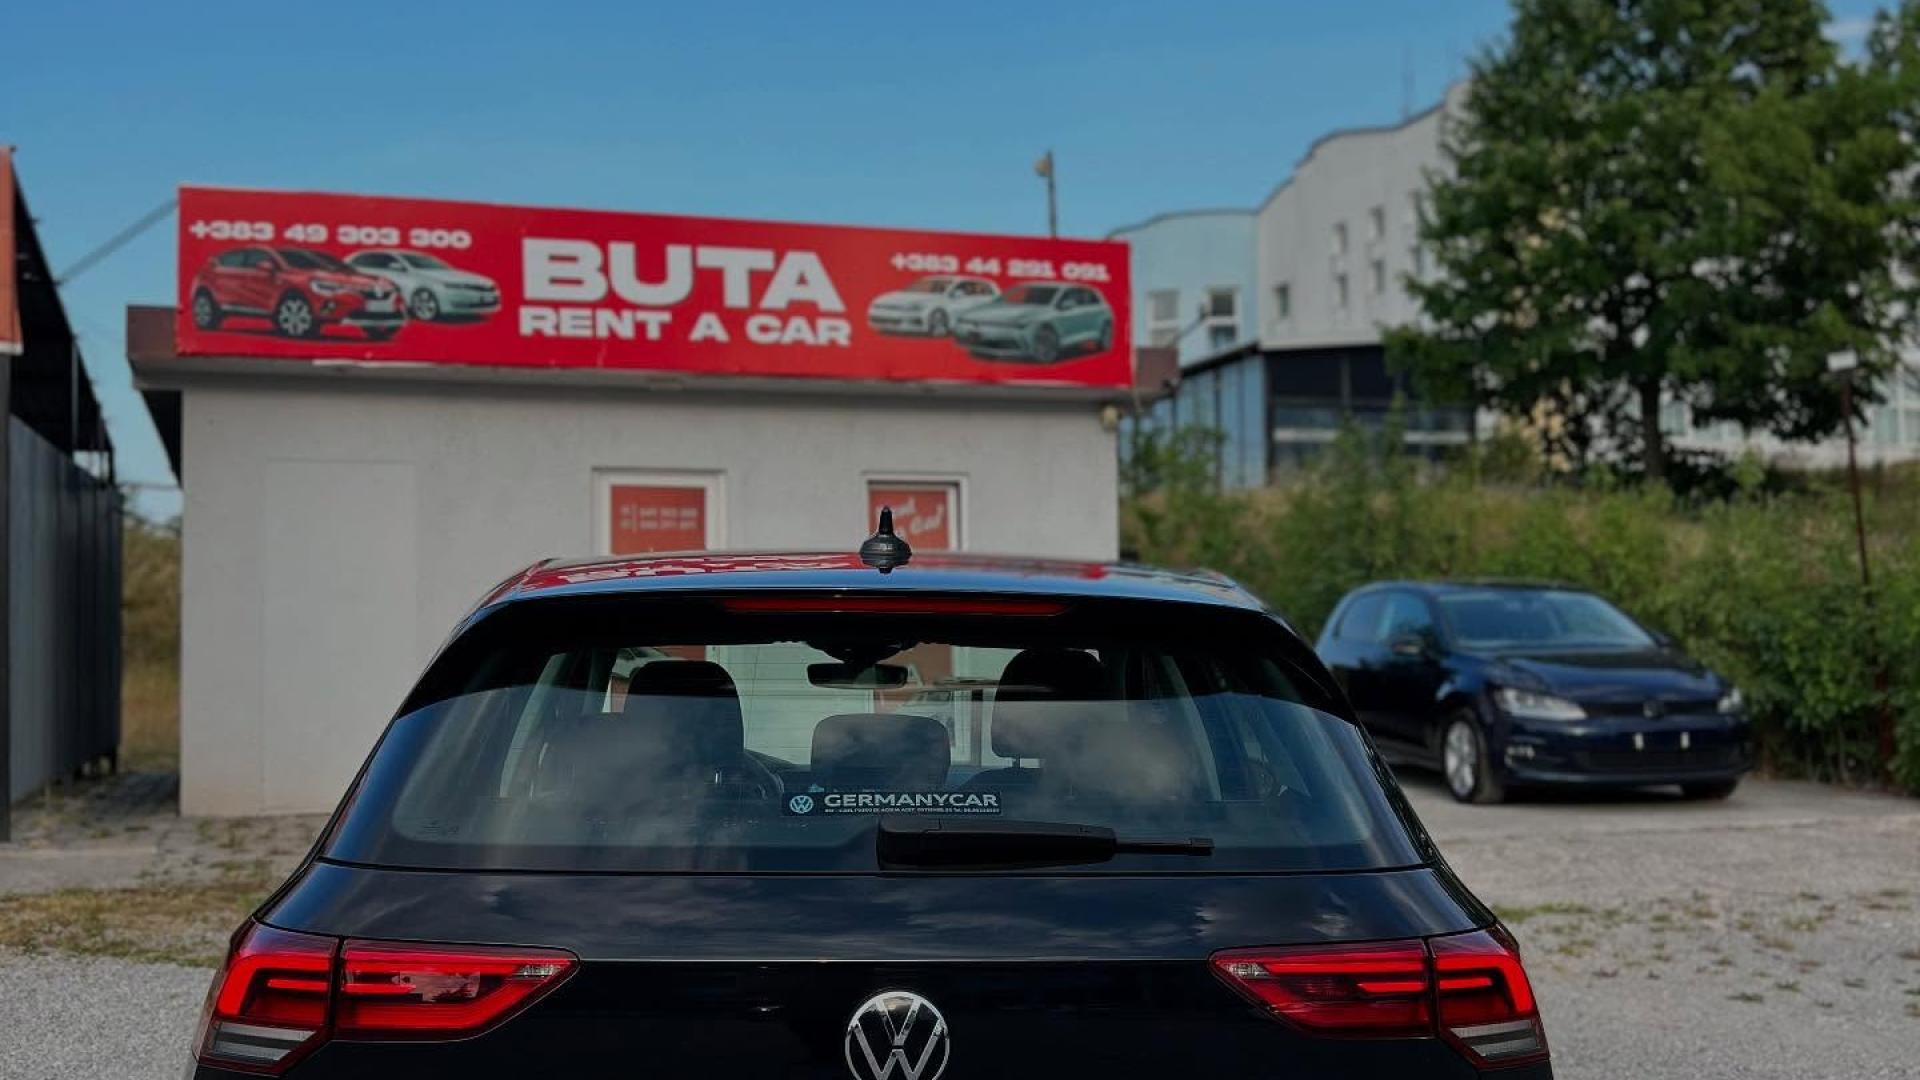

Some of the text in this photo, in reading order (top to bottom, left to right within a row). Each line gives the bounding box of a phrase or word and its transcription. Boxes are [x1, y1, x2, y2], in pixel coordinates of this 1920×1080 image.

[190, 220, 472, 249] +383 49 303 300
[520, 238, 846, 313] BUTA
[890, 252, 959, 273] +383
[965, 256, 1001, 276] 44
[519, 307, 852, 346] RENT A CAR
[824, 793, 999, 807] GERMANYCAR
